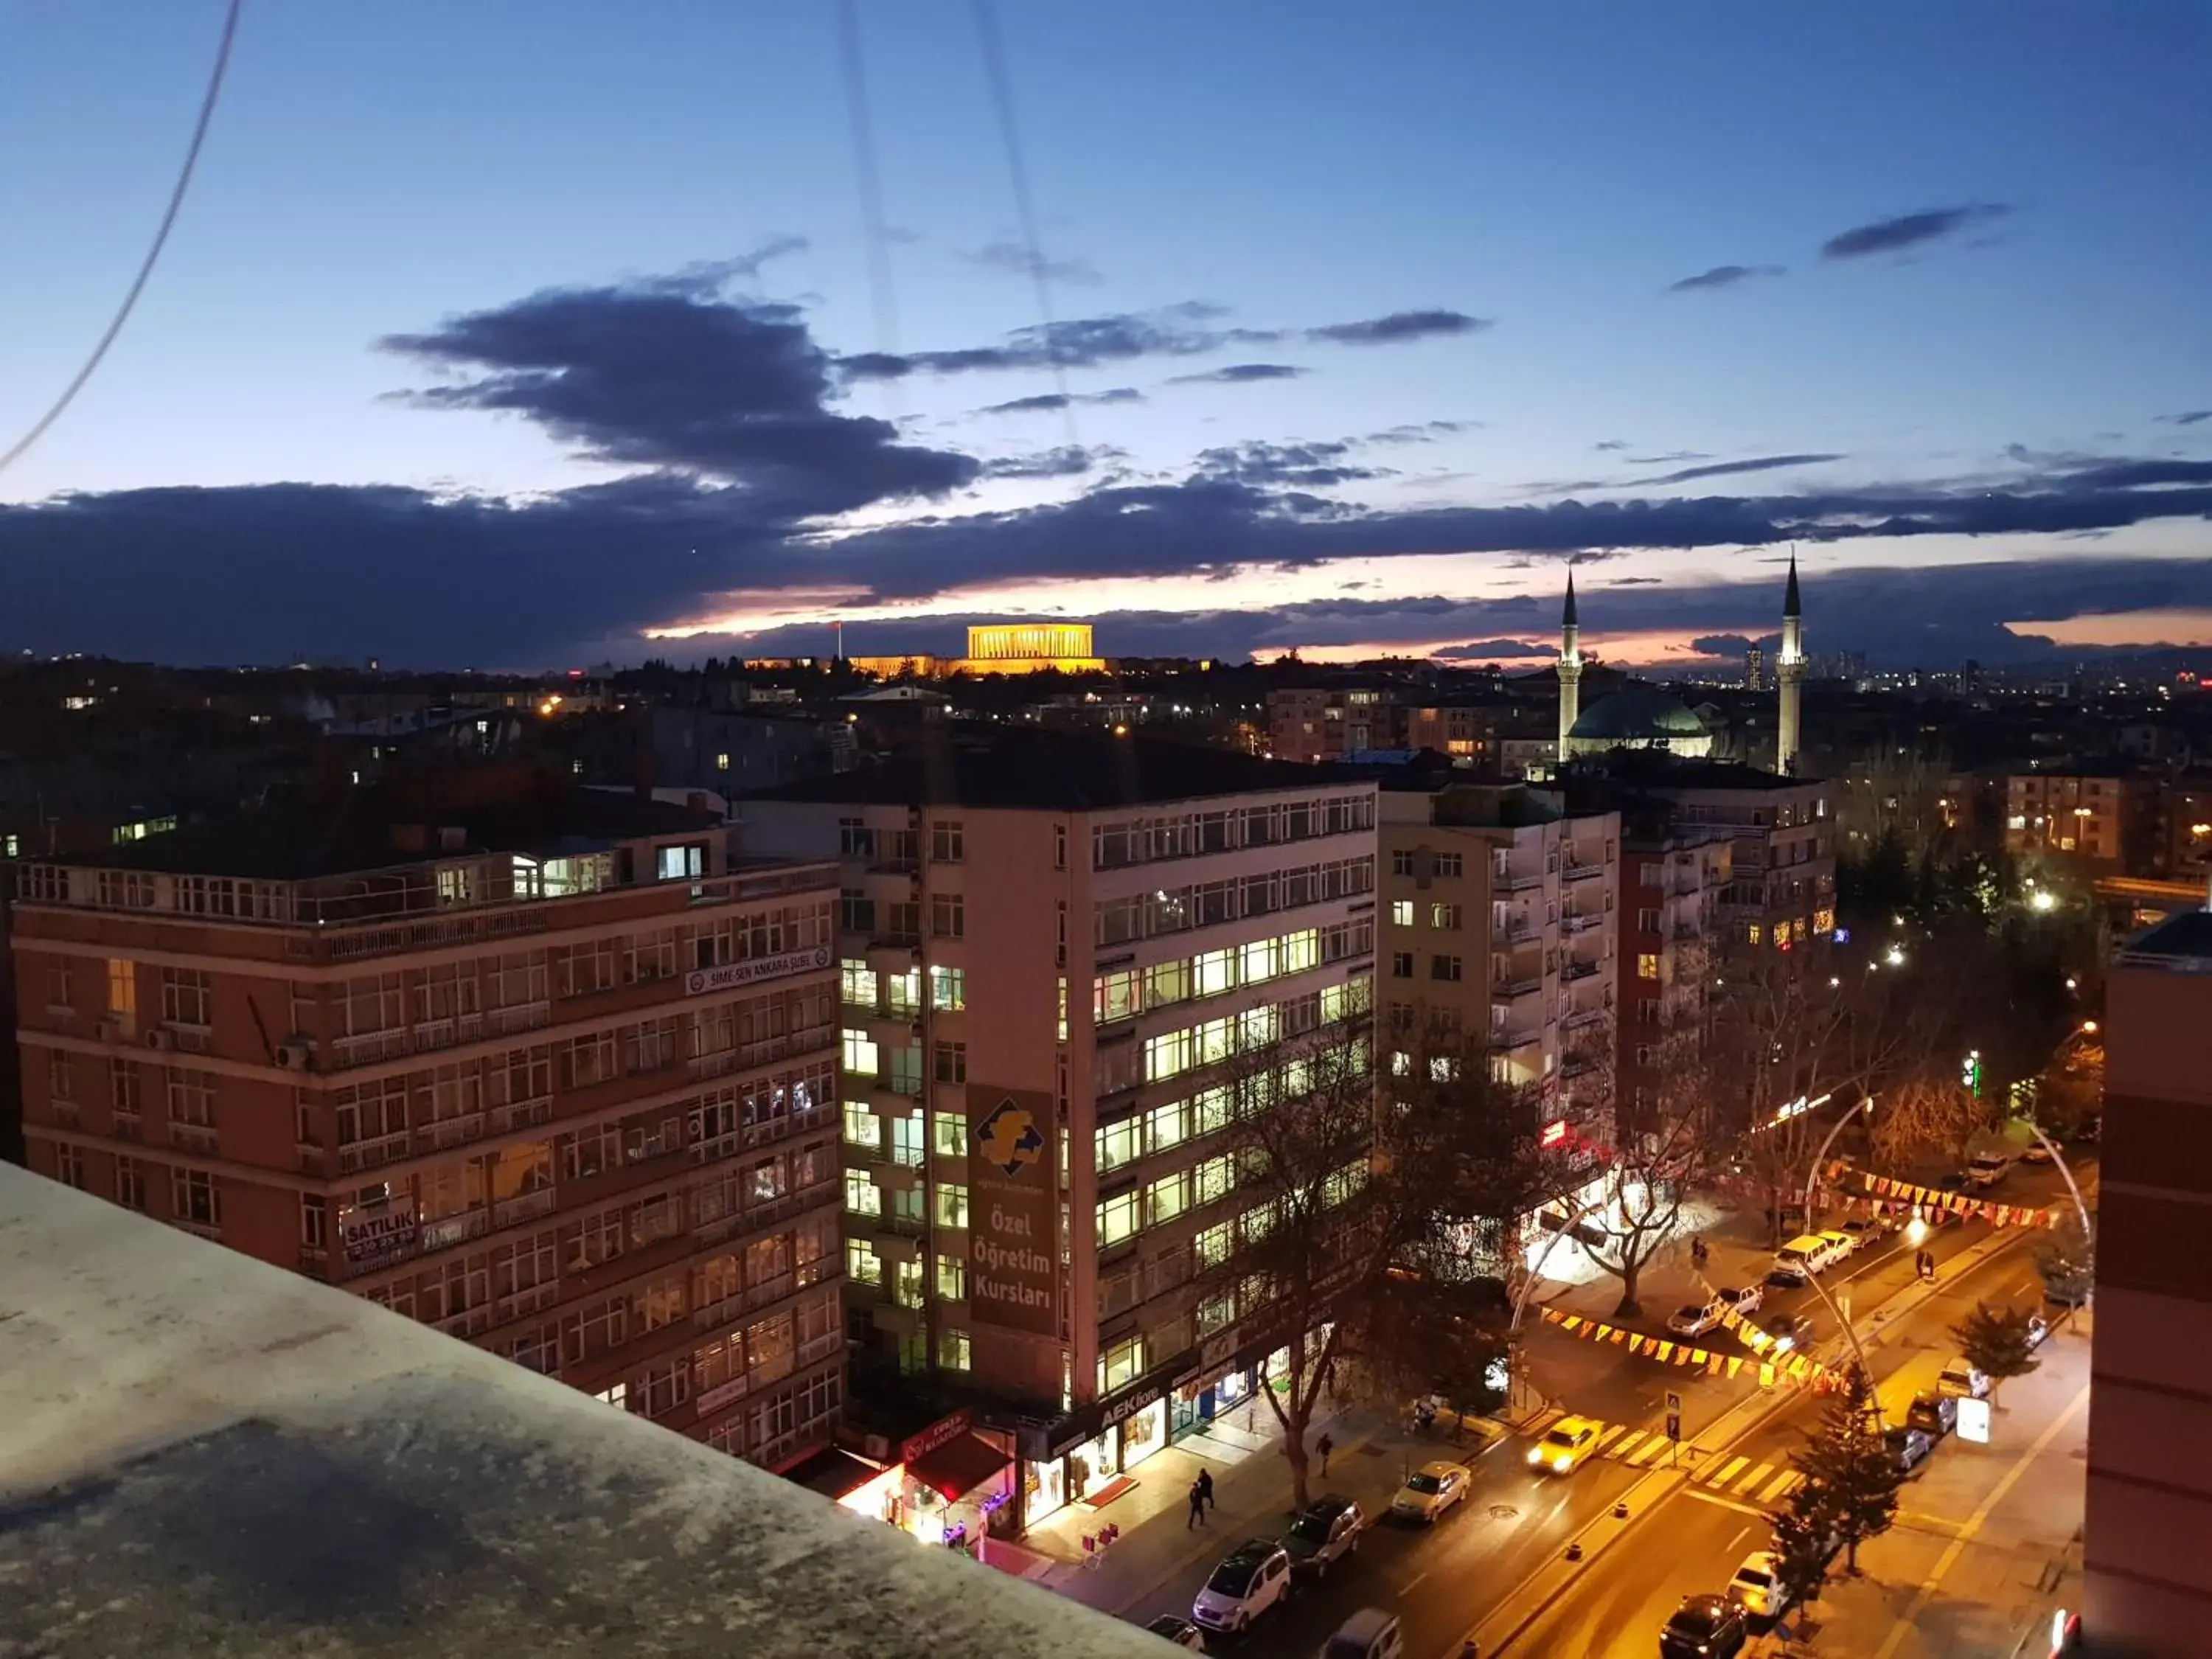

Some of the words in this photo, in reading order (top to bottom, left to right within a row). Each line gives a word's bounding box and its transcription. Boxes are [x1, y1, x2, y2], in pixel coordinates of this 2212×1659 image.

[754, 959, 789, 975] ANKARA
[347, 1210, 414, 1242] SATILIK
[991, 1203, 1032, 1237] Özel
[974, 1234, 1050, 1273] Öğretim
[975, 1273, 1050, 1308] Kursları
